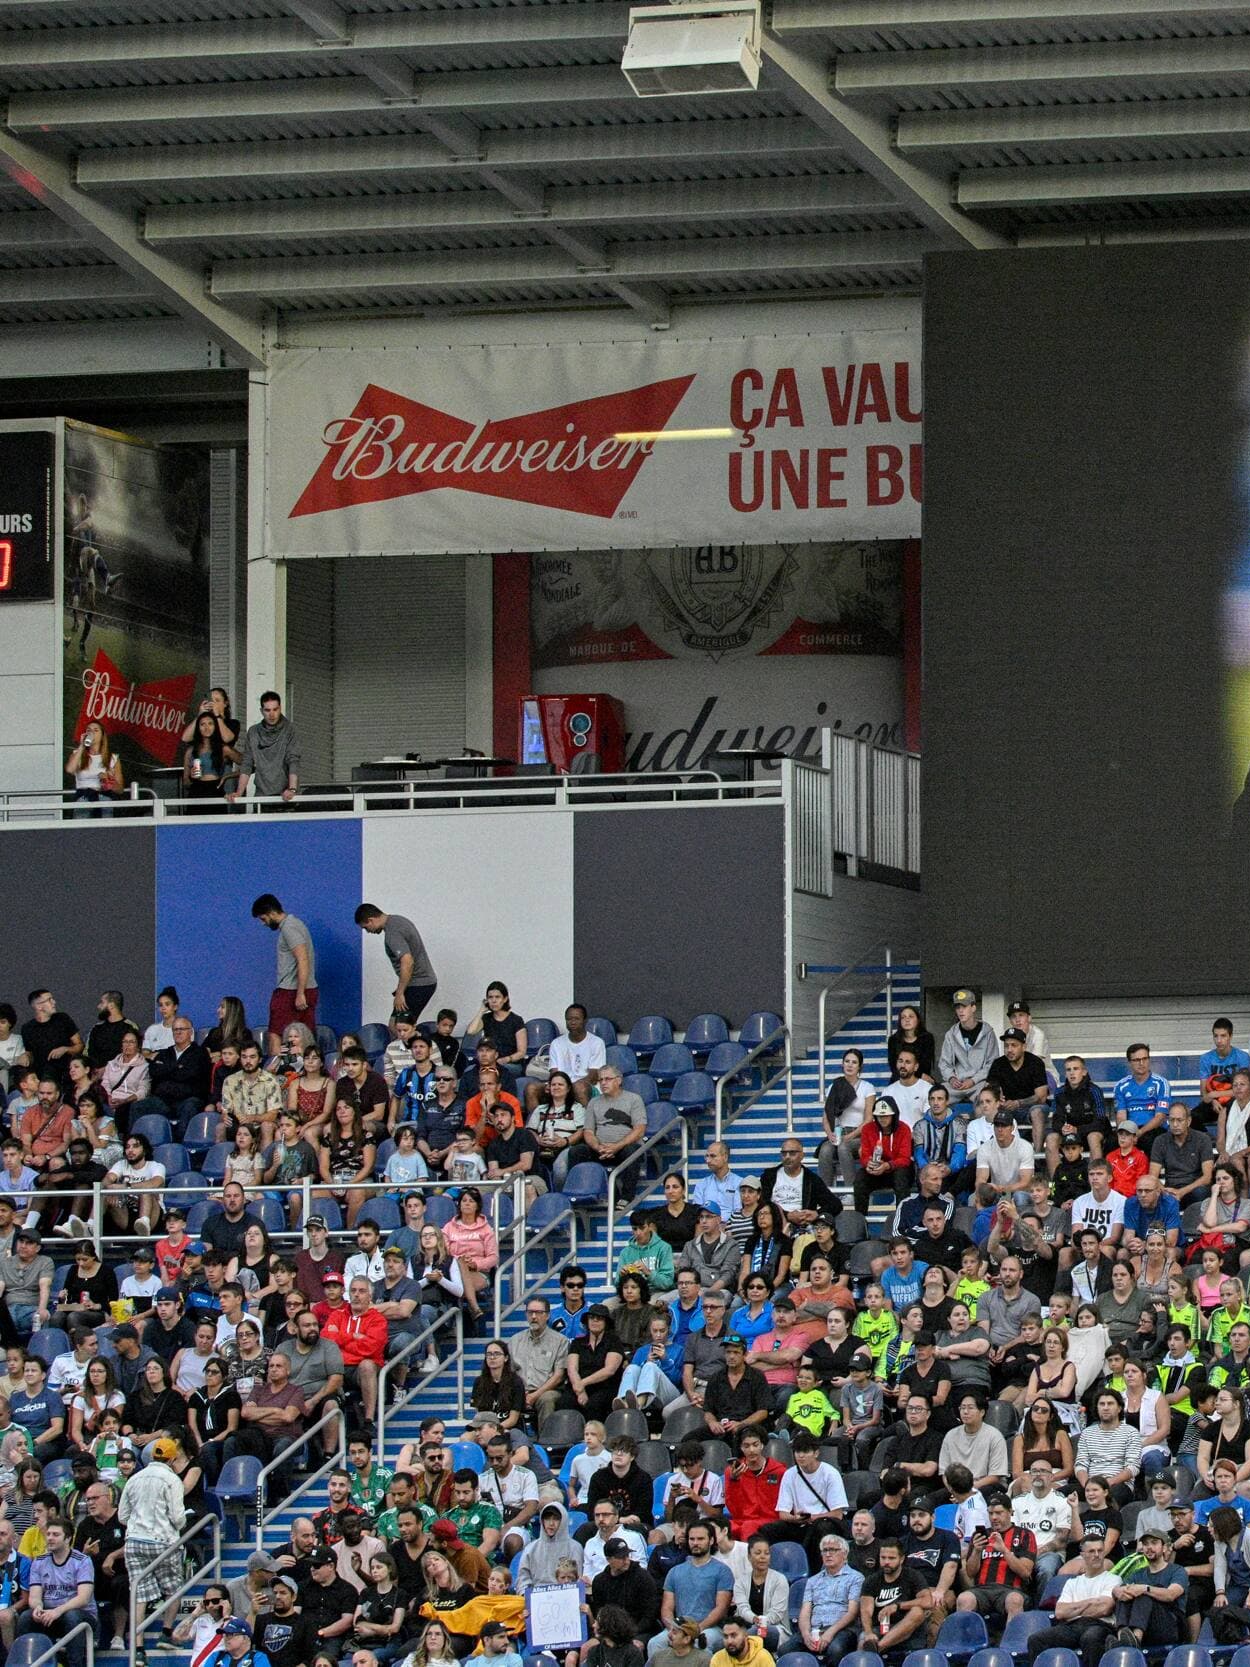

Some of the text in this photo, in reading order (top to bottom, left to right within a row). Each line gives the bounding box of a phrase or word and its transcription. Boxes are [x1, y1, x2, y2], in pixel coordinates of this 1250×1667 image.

[729, 367, 805, 448] ÇA
[321, 414, 653, 480] Budweiser
[728, 448, 848, 513] UNE
[620, 641, 637, 652] DE
[799, 634, 863, 646] COMMERCE
[82, 668, 186, 734] Budweiser
[1082, 1207, 1112, 1225] JUST
[14, 1402, 46, 1413] adidas
[878, 1586, 900, 1600] NIKE
